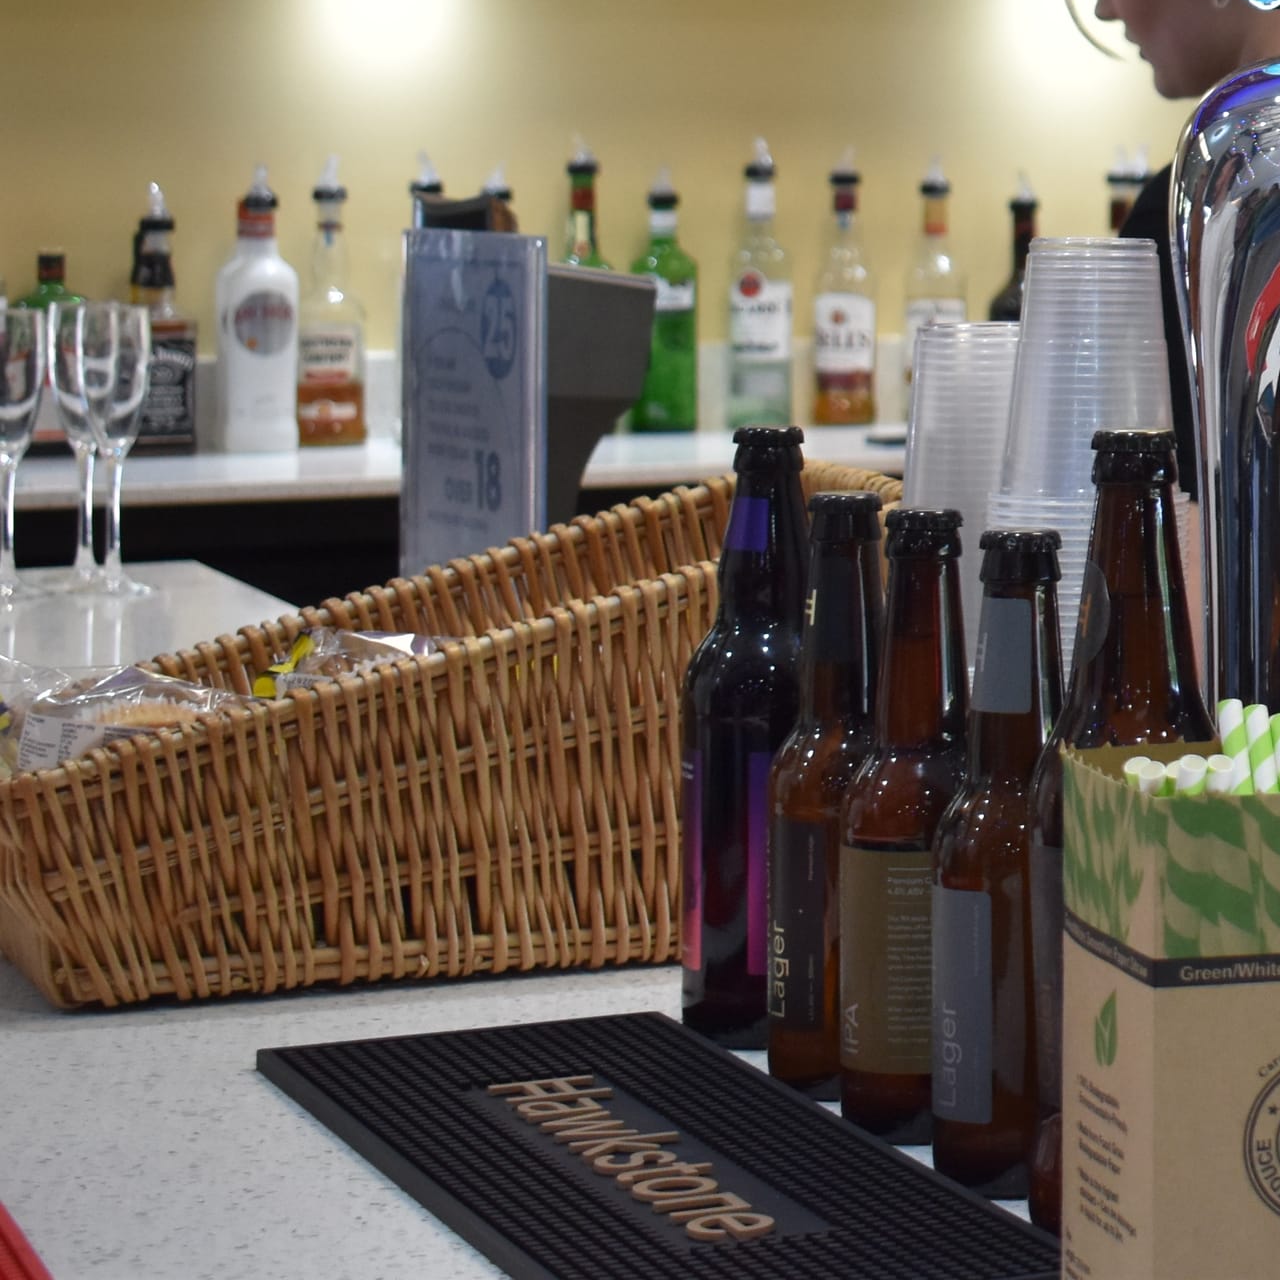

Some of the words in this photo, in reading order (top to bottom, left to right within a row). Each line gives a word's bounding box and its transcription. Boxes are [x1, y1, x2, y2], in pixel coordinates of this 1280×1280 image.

[475, 450, 502, 512] 18
[768, 920, 790, 1018] Lager
[843, 1002, 860, 1055] IPA
[939, 1001, 963, 1108] Lager
[487, 1074, 776, 1242] Hawkstone
